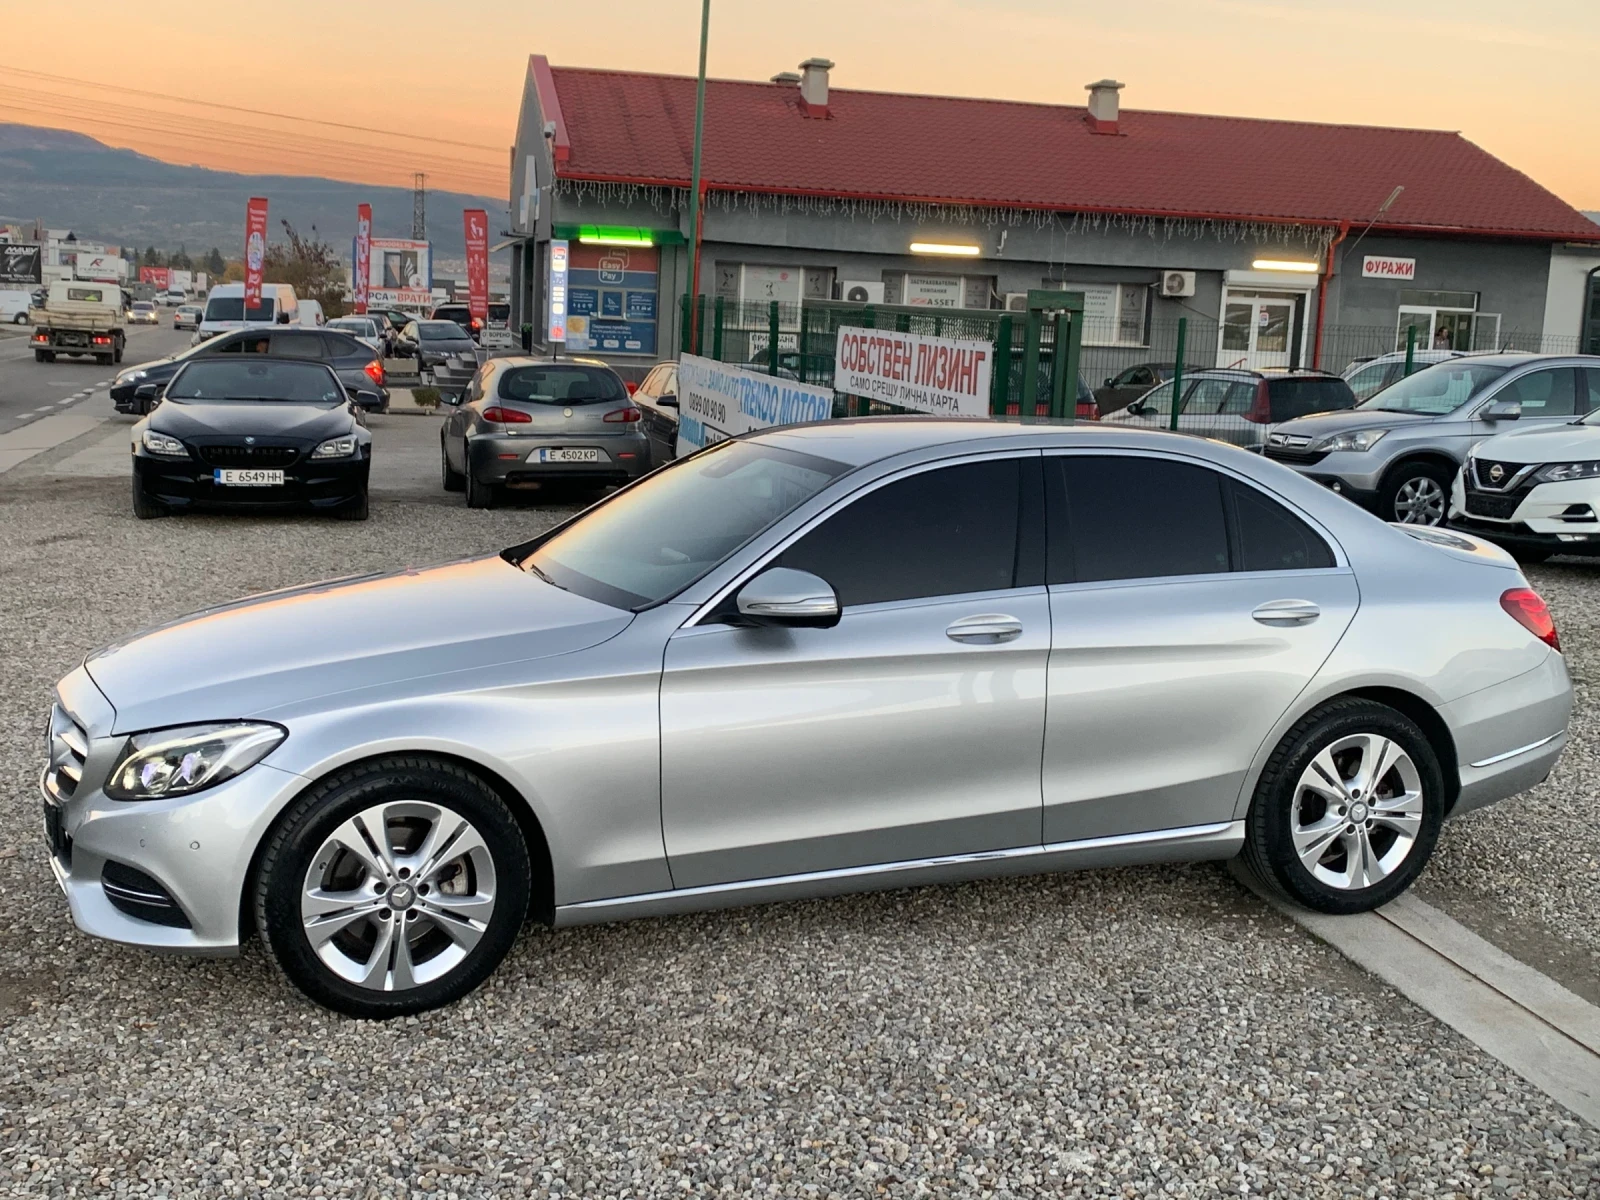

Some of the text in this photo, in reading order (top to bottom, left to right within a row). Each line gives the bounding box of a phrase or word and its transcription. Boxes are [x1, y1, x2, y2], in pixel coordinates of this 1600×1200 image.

[602, 261, 621, 270] Easy
[1365, 260, 1413, 276] ФУРАЖИ
[602, 272, 617, 281] Pay
[397, 293, 431, 303] ВРАТИ
[927, 298, 956, 307] ASSET
[482, 330, 511, 338] ОВОРЕНО
[841, 333, 986, 397] СОБСТВЕН ЛИЗИНГ
[850, 375, 960, 413] САМО СРЕЩУ ЛИЧНА КАРТА
[689, 392, 702, 413] 0899
[739, 377, 779, 425] TRENDO
